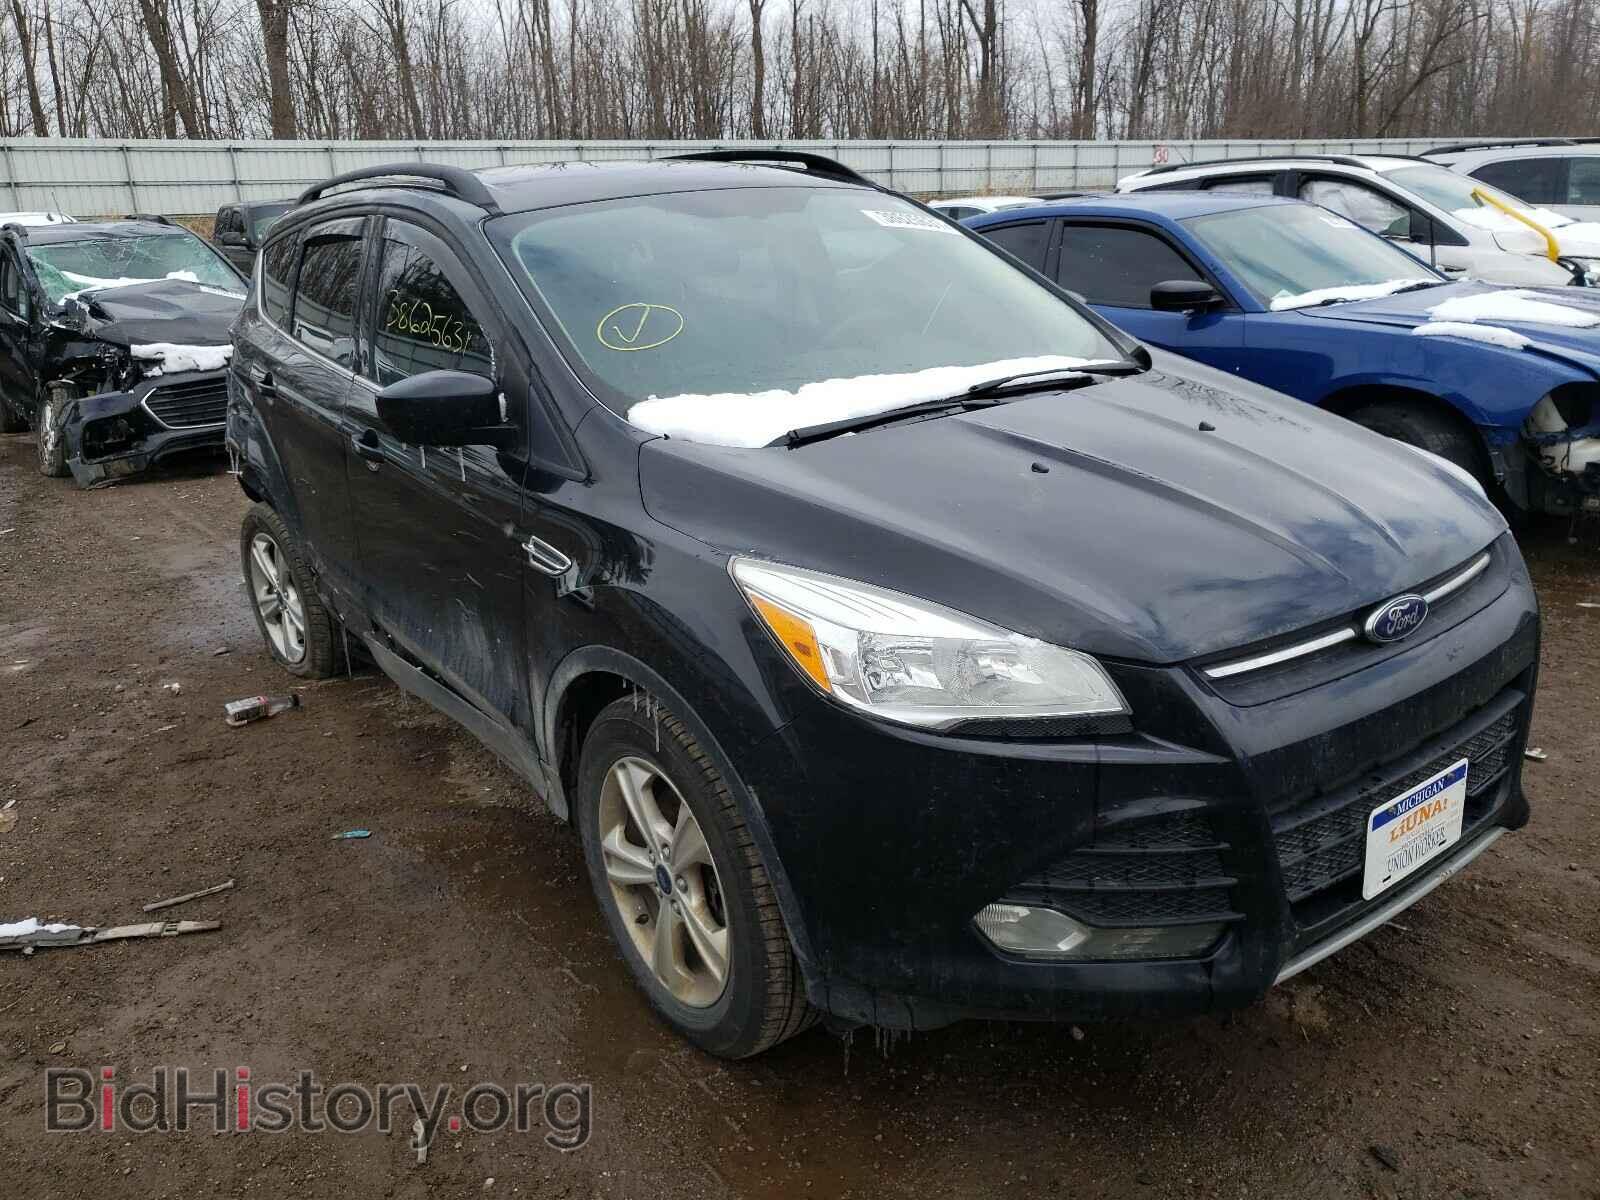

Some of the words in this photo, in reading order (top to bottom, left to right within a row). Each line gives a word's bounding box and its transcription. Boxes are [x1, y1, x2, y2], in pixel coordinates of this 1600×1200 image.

[1387, 602, 1420, 634] Ford
[1396, 778, 1445, 816] MICHIGAN
[1387, 845, 1415, 873] UNION
[1414, 825, 1446, 862] WORKER
